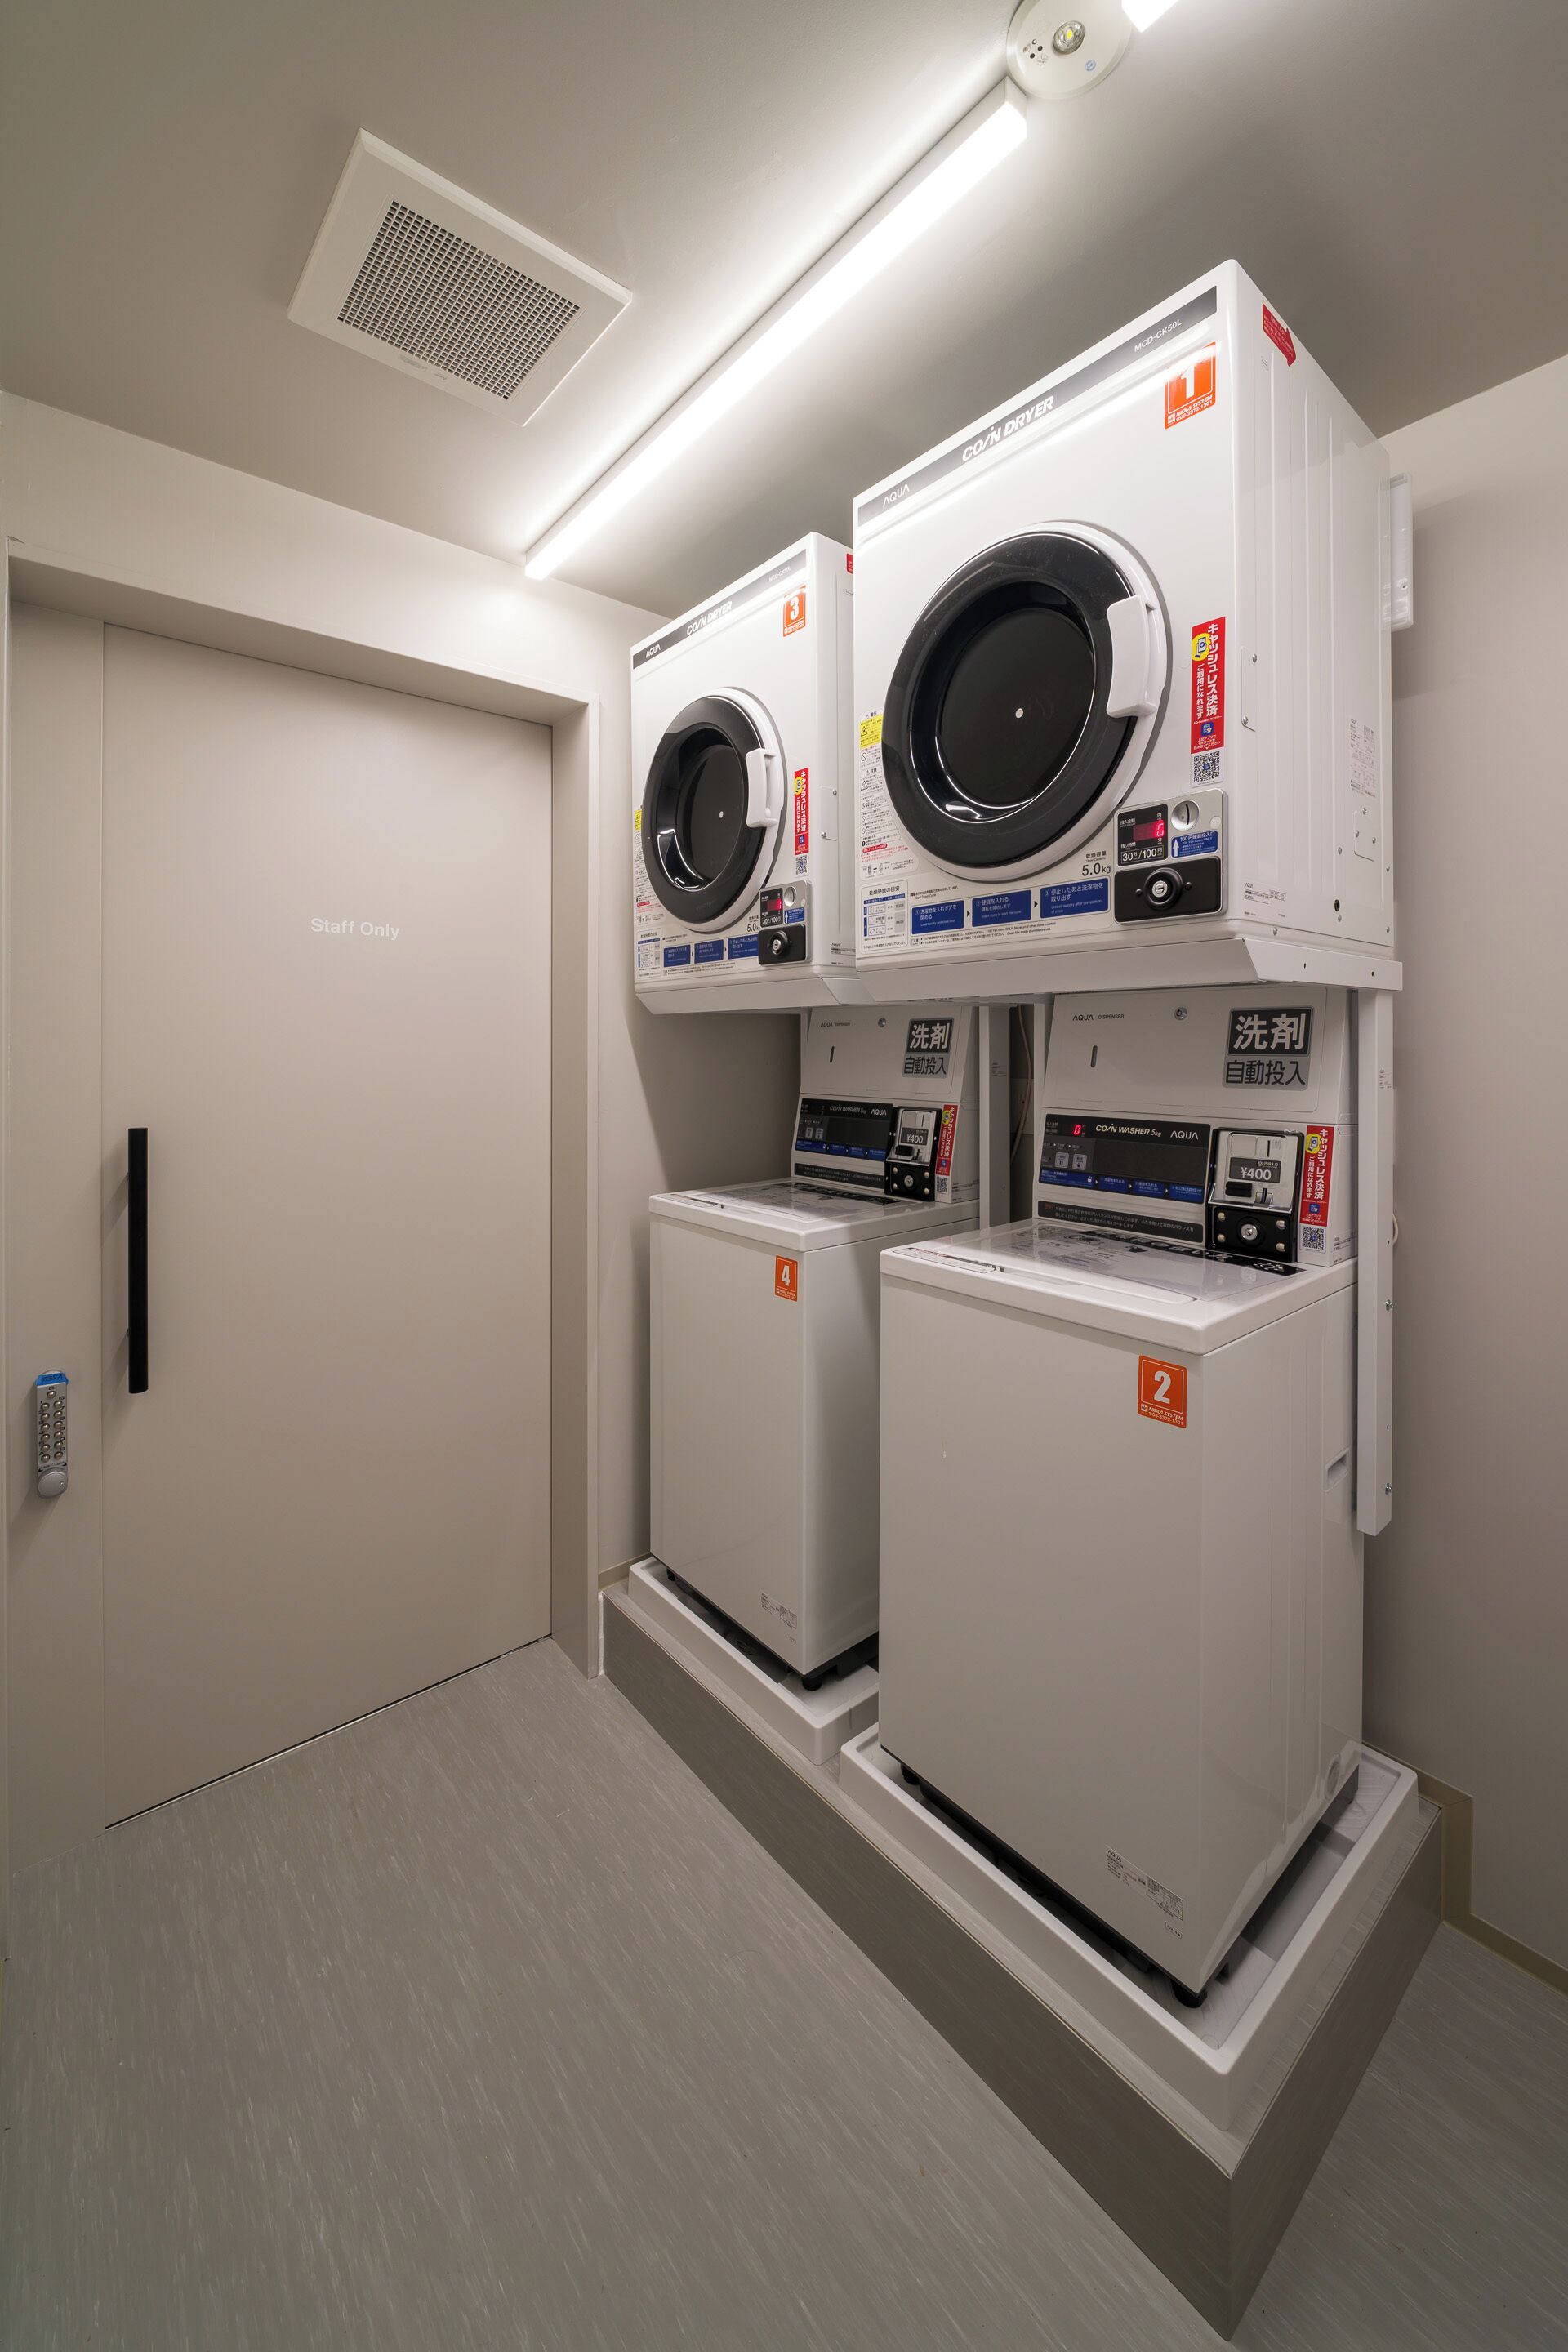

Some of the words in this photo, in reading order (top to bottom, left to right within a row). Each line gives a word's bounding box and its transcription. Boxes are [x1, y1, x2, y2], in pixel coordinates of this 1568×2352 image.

[1134, 319, 1183, 352] MCD-CK50L
[1180, 364, 1196, 399] 1
[1004, 395, 1054, 438] DRYER
[883, 483, 910, 508] AQUA
[707, 601, 733, 623] DRYER
[790, 595, 800, 620] 3
[645, 644, 662, 658] AQUA
[1206, 623, 1219, 717] キャッシュレス決済
[1196, 663, 1205, 719] ご利用になれます
[310, 917, 354, 933] Staff
[360, 921, 400, 941] Only
[910, 1023, 950, 1049] 洗剤
[1233, 1013, 1307, 1050] 洗剤
[903, 1057, 947, 1076] 自動投入
[1226, 1059, 1307, 1086] 自動投入
[871, 1108, 887, 1116] AQUA
[906, 1134, 924, 1144] ¥400
[1073, 1125, 1082, 1135] 0
[1118, 1126, 1150, 1135] WASHER
[1151, 1129, 1162, 1138] 5kg
[1169, 1130, 1199, 1140] AQUA
[1241, 1166, 1272, 1181] ¥400
[1313, 1129, 1329, 1200] キャッシュレス決済
[1306, 1156, 1316, 1199] ご利用になれます
[782, 1265, 791, 1286] 4
[1154, 1370, 1172, 1405] 2
[1164, 1411, 1184, 1421] SYSTEM
